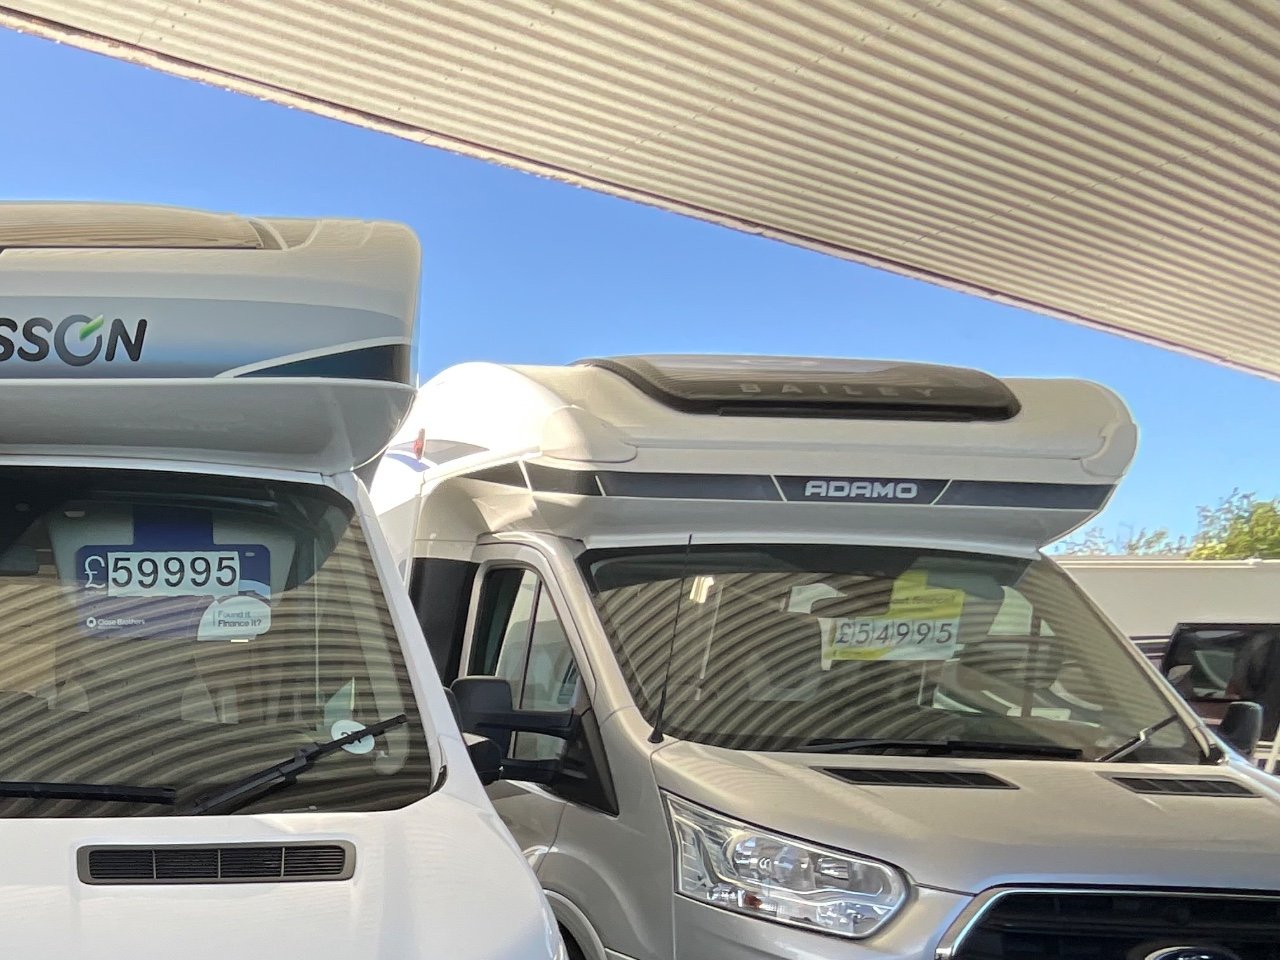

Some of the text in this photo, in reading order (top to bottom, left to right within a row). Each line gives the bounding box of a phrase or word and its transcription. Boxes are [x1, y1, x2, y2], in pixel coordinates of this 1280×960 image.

[740, 383, 936, 398] BAILEY
[804, 480, 918, 499] ADAMO
[84, 555, 237, 589] £59995
[218, 619, 249, 627] Finance
[835, 622, 953, 645] £54995
